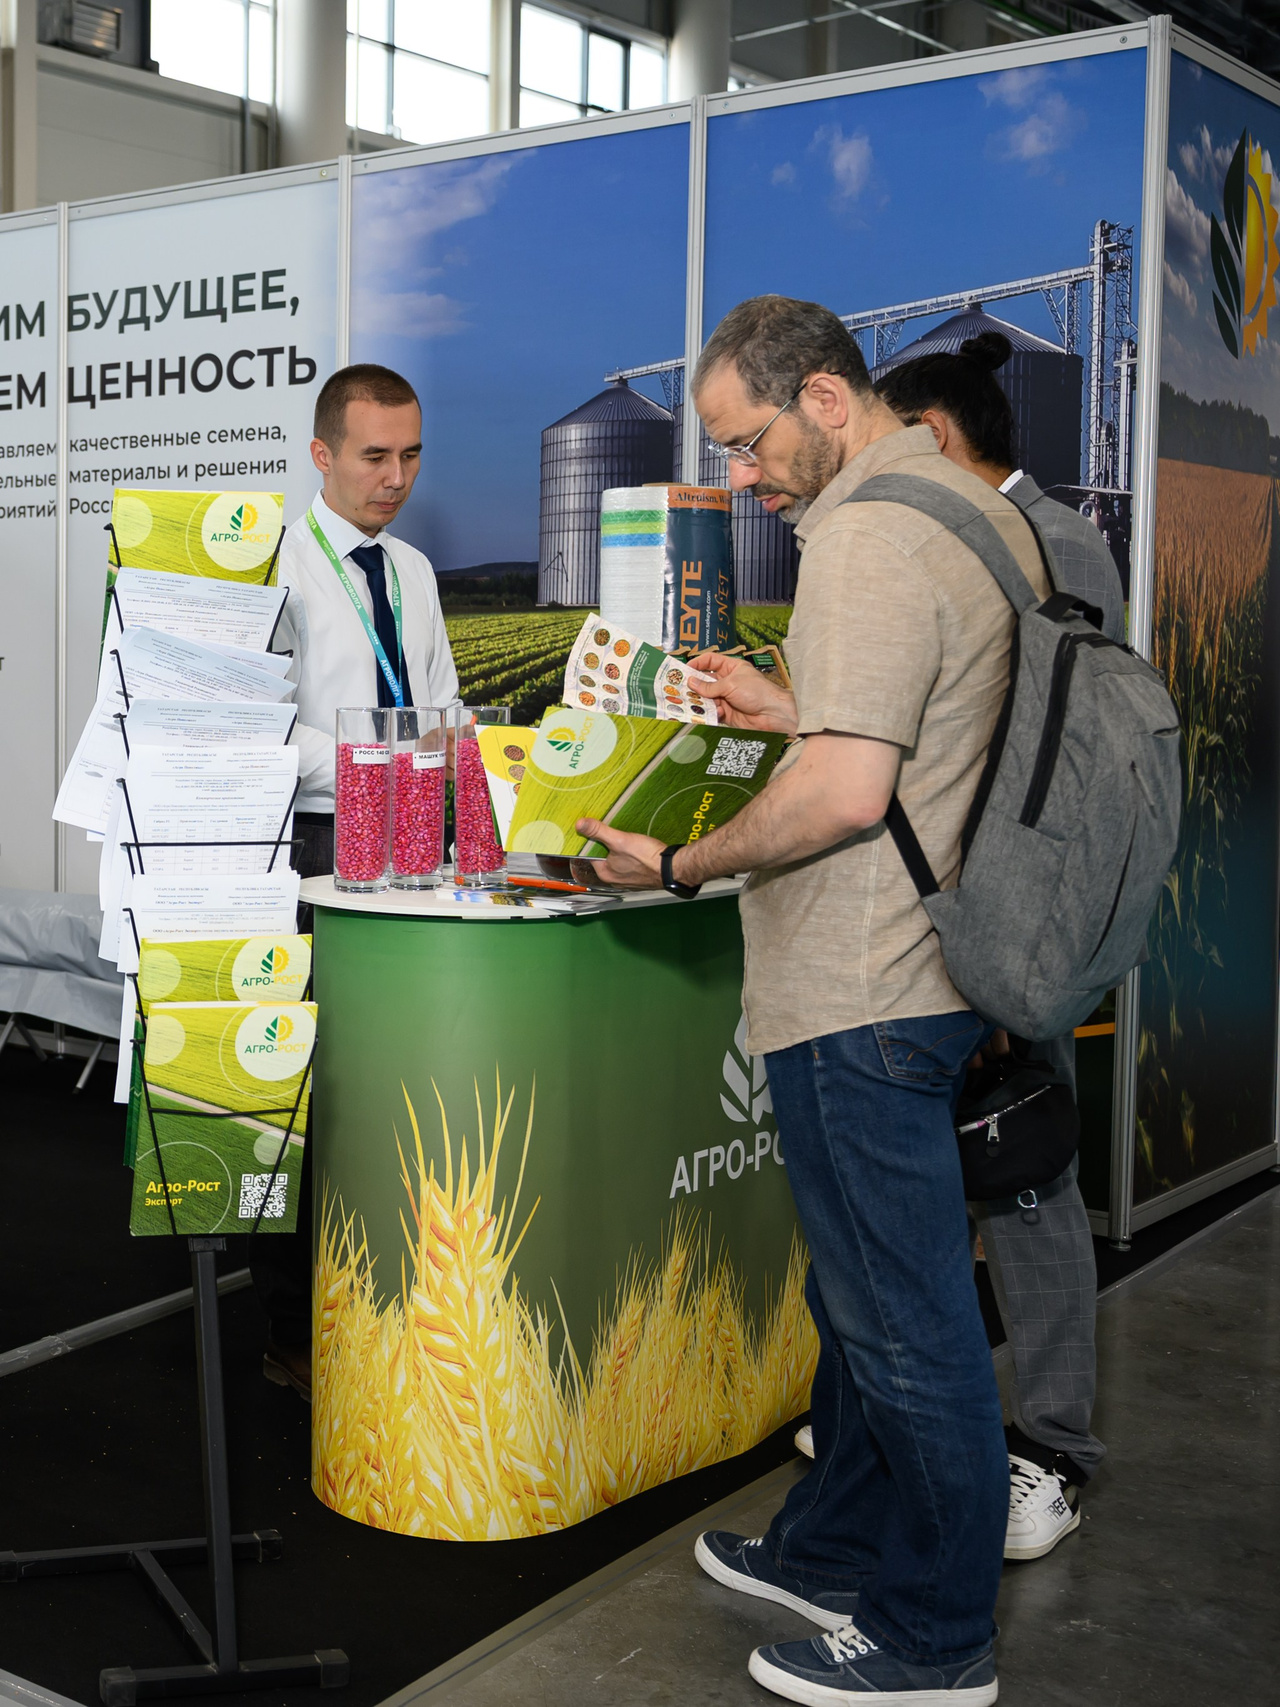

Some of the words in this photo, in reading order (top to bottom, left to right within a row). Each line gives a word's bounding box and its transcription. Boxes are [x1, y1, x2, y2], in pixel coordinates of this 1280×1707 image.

[67, 268, 300, 334] БУДУЩЕЕ,
[67, 345, 318, 409] ЦЕННОСТЬ
[69, 430, 201, 453] качественные
[206, 425, 287, 445] семена,
[69, 465, 171, 486] материалы
[177, 464, 188, 479] и
[194, 459, 287, 482] решения
[210, 532, 271, 544] АГРО-РОСТ
[339, 572, 362, 610] АГРОВОЛГА
[380, 658, 400, 698] АГРОВОЛГА
[569, 715, 595, 769] АГРО-РОСТ
[241, 973, 304, 988] АГРО-РОСТ
[244, 1043, 308, 1055] АГРО-РОСТ
[145, 1197, 183, 1207] Экспрт
